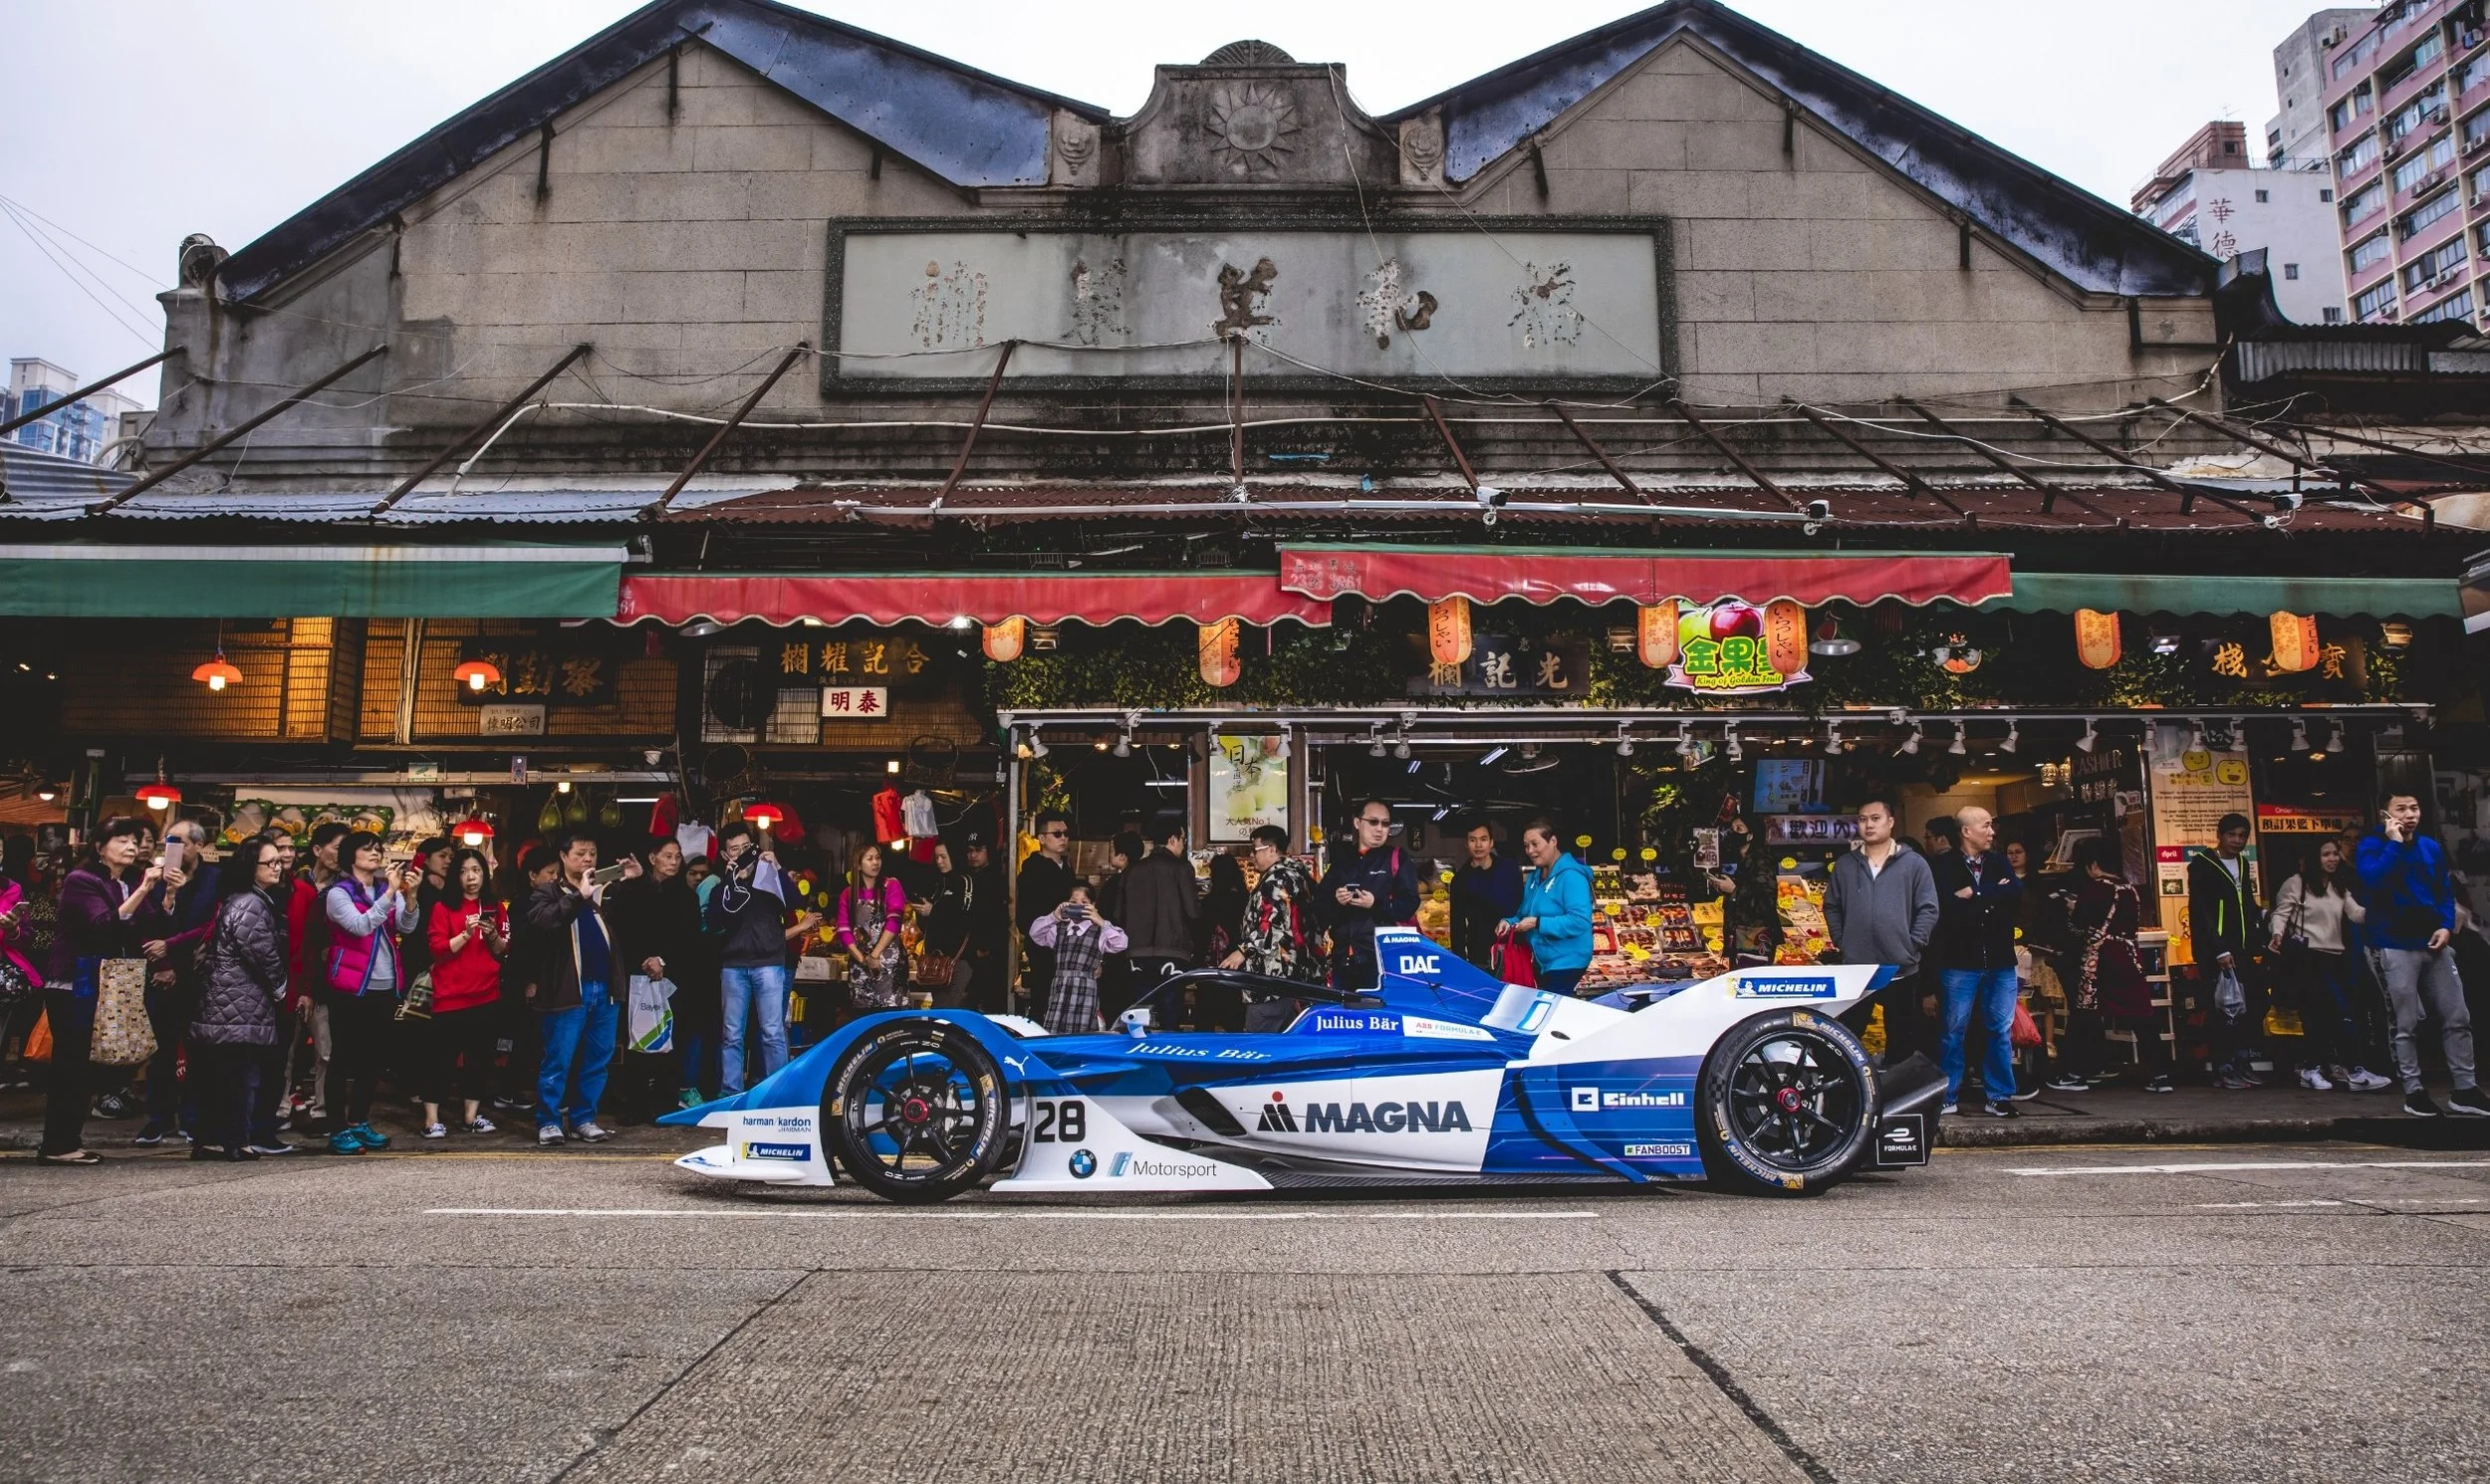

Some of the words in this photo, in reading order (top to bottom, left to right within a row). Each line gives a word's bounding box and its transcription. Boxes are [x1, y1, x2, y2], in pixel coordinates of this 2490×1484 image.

[1696, 676, 1716, 687] King
[1718, 676, 1727, 686] of
[1729, 675, 1761, 685] Golden
[1762, 674, 1782, 683] Fruit
[1399, 955, 1441, 975] DAC
[1758, 983, 1828, 993] MICHELIN
[1316, 1015, 1364, 1032] Julius
[1370, 1016, 1399, 1032] Bär
[1415, 1021, 1433, 1030] ABB
[1125, 1042, 1210, 1058] Julius
[1214, 1049, 1273, 1060] Bär
[1819, 1021, 1866, 1063] MICHELIN
[837, 1043, 873, 1095] MICHELIN
[1604, 1093, 1685, 1107] Einhell
[1034, 1100, 1086, 1143] 28
[1305, 1101, 1473, 1133] MAGNA
[975, 1097, 996, 1158] MICHELIN
[760, 1147, 805, 1157] MICHELIN
[1625, 1144, 1689, 1155] #FANBOOST
[1133, 1160, 1217, 1179] Motorsport
[1727, 1143, 1778, 1182] MICHELIN
